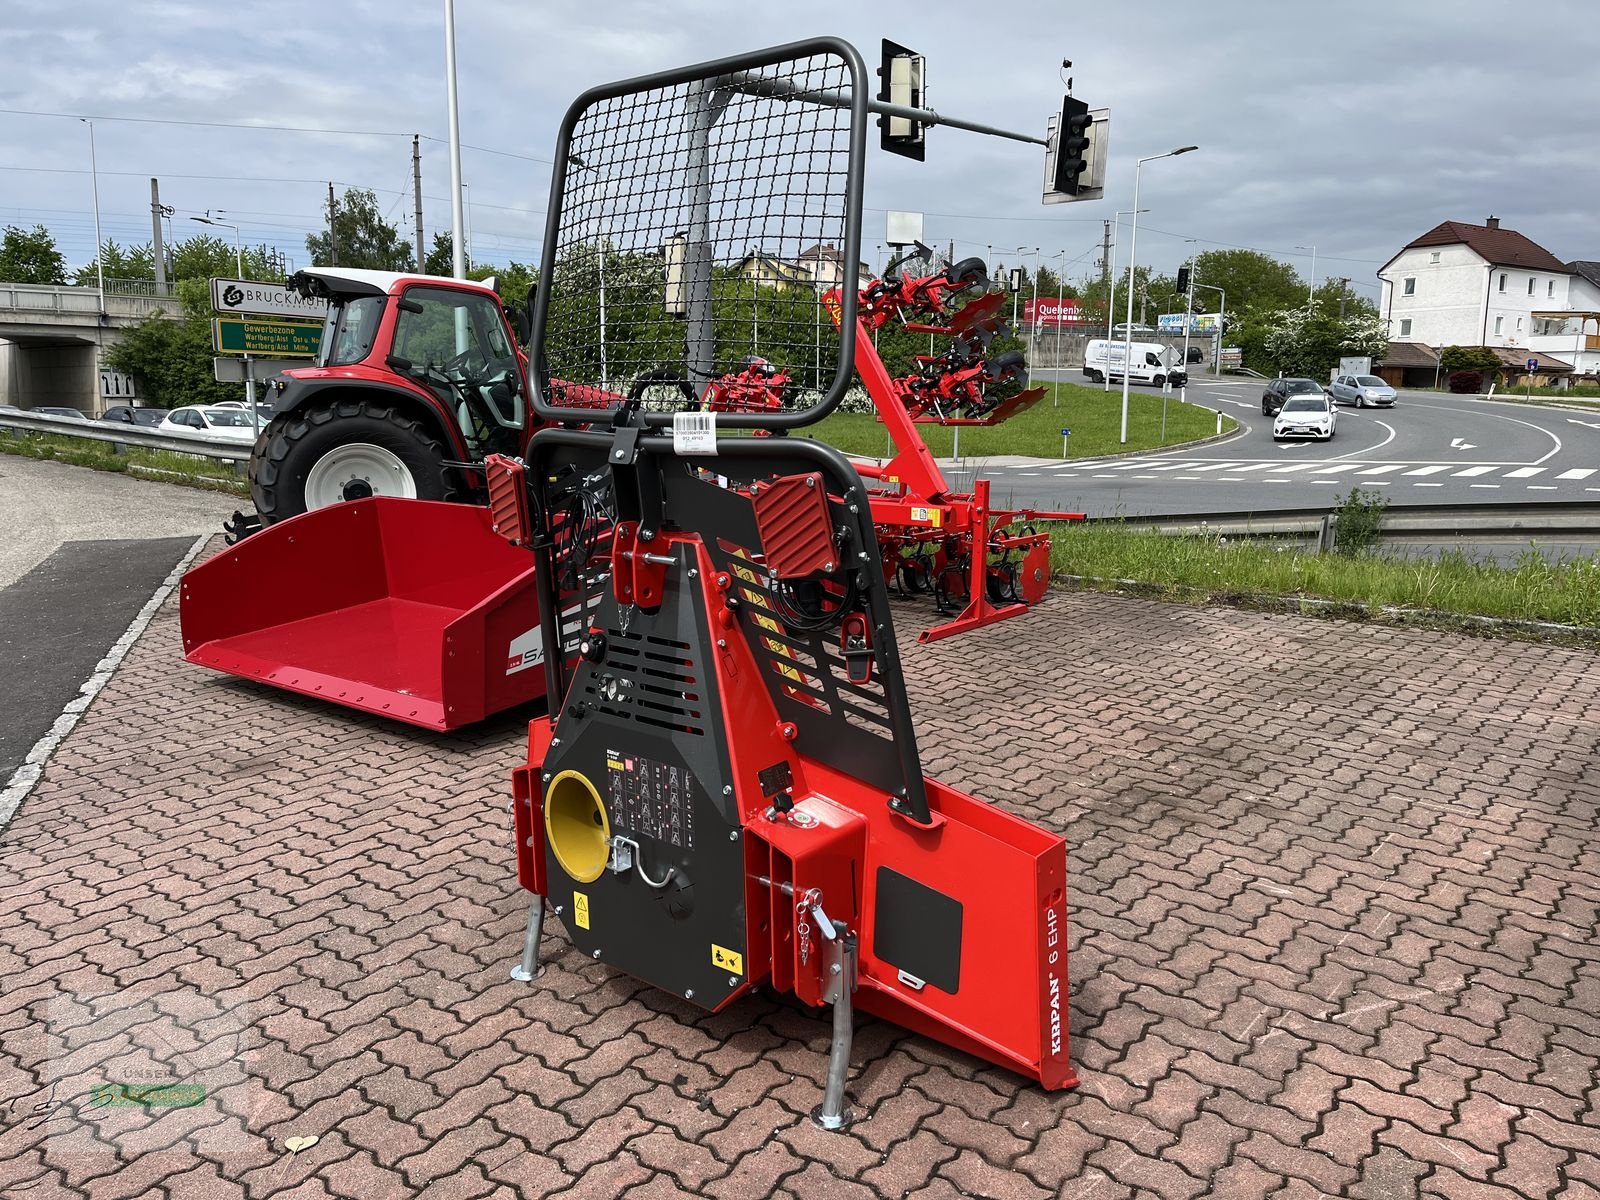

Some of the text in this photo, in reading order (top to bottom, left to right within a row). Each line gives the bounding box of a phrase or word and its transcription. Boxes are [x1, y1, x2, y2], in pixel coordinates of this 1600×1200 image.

[244, 324, 295, 335] Gewerbezone
[244, 333, 289, 343] Wartberg/Aist
[1047, 908, 1061, 1056] KRPAN 6 EHP
